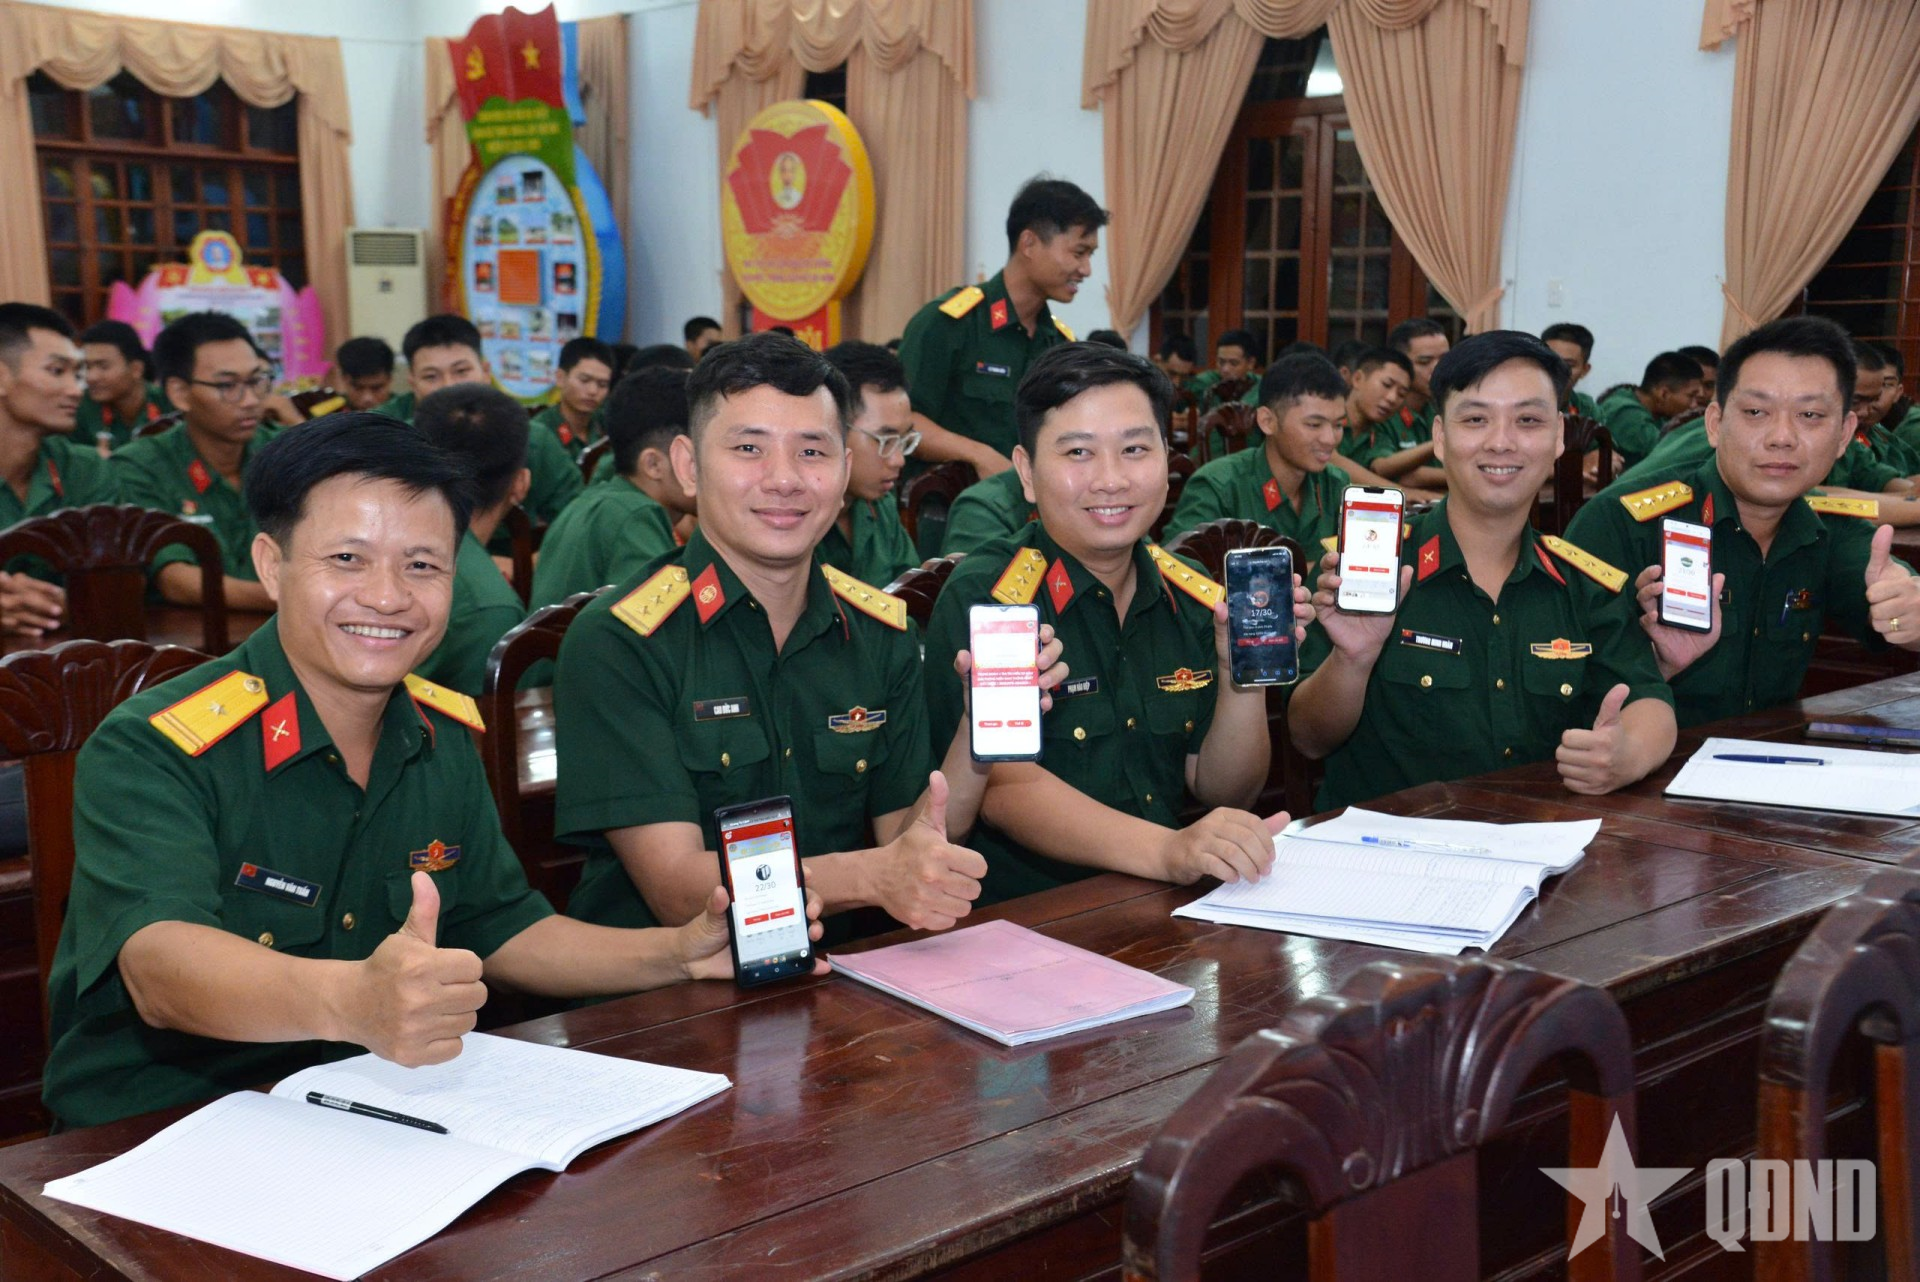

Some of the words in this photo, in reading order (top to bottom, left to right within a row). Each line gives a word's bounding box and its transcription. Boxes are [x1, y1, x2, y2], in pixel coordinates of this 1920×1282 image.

[1251, 608, 1272, 617] 17/30
[264, 876, 286, 891] NGUYỄN
[755, 881, 777, 892] 22/30
